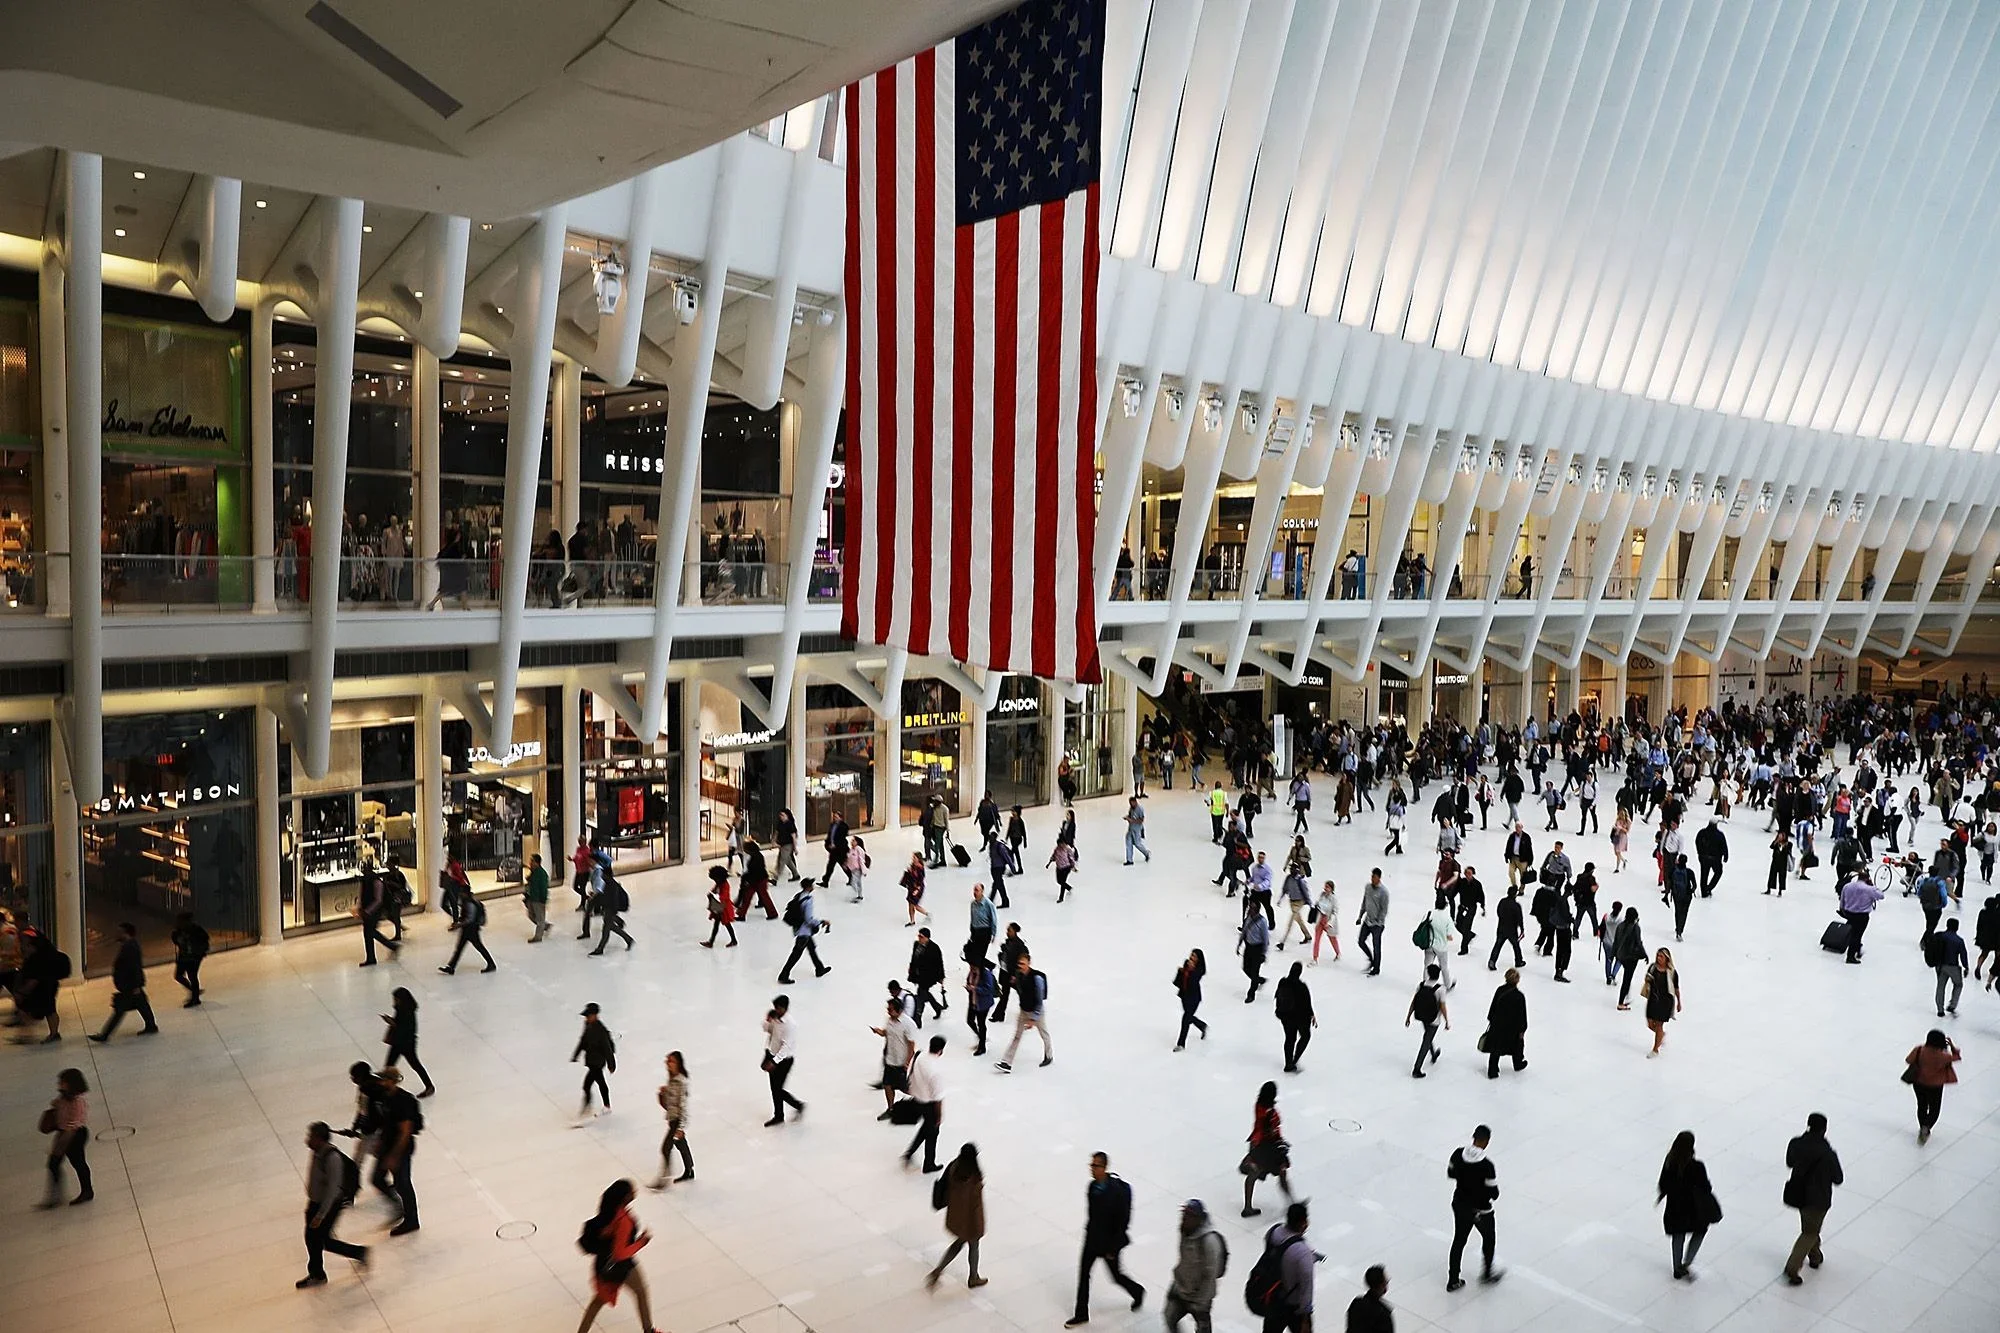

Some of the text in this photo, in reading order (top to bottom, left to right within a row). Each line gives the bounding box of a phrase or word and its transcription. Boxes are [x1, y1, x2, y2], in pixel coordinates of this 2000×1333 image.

[101, 398, 228, 442] Sam Edelman
[606, 454, 664, 473] REISS
[1283, 518, 1305, 529] COLE
[1631, 656, 1656, 670] COS
[1308, 676, 1324, 686] COIN
[999, 697, 1038, 713] LONDON
[905, 711, 967, 728] BREITLING
[713, 730, 770, 748] MONTBLANC
[468, 741, 541, 763] LOINES
[101, 783, 240, 812] SMYTHSON
